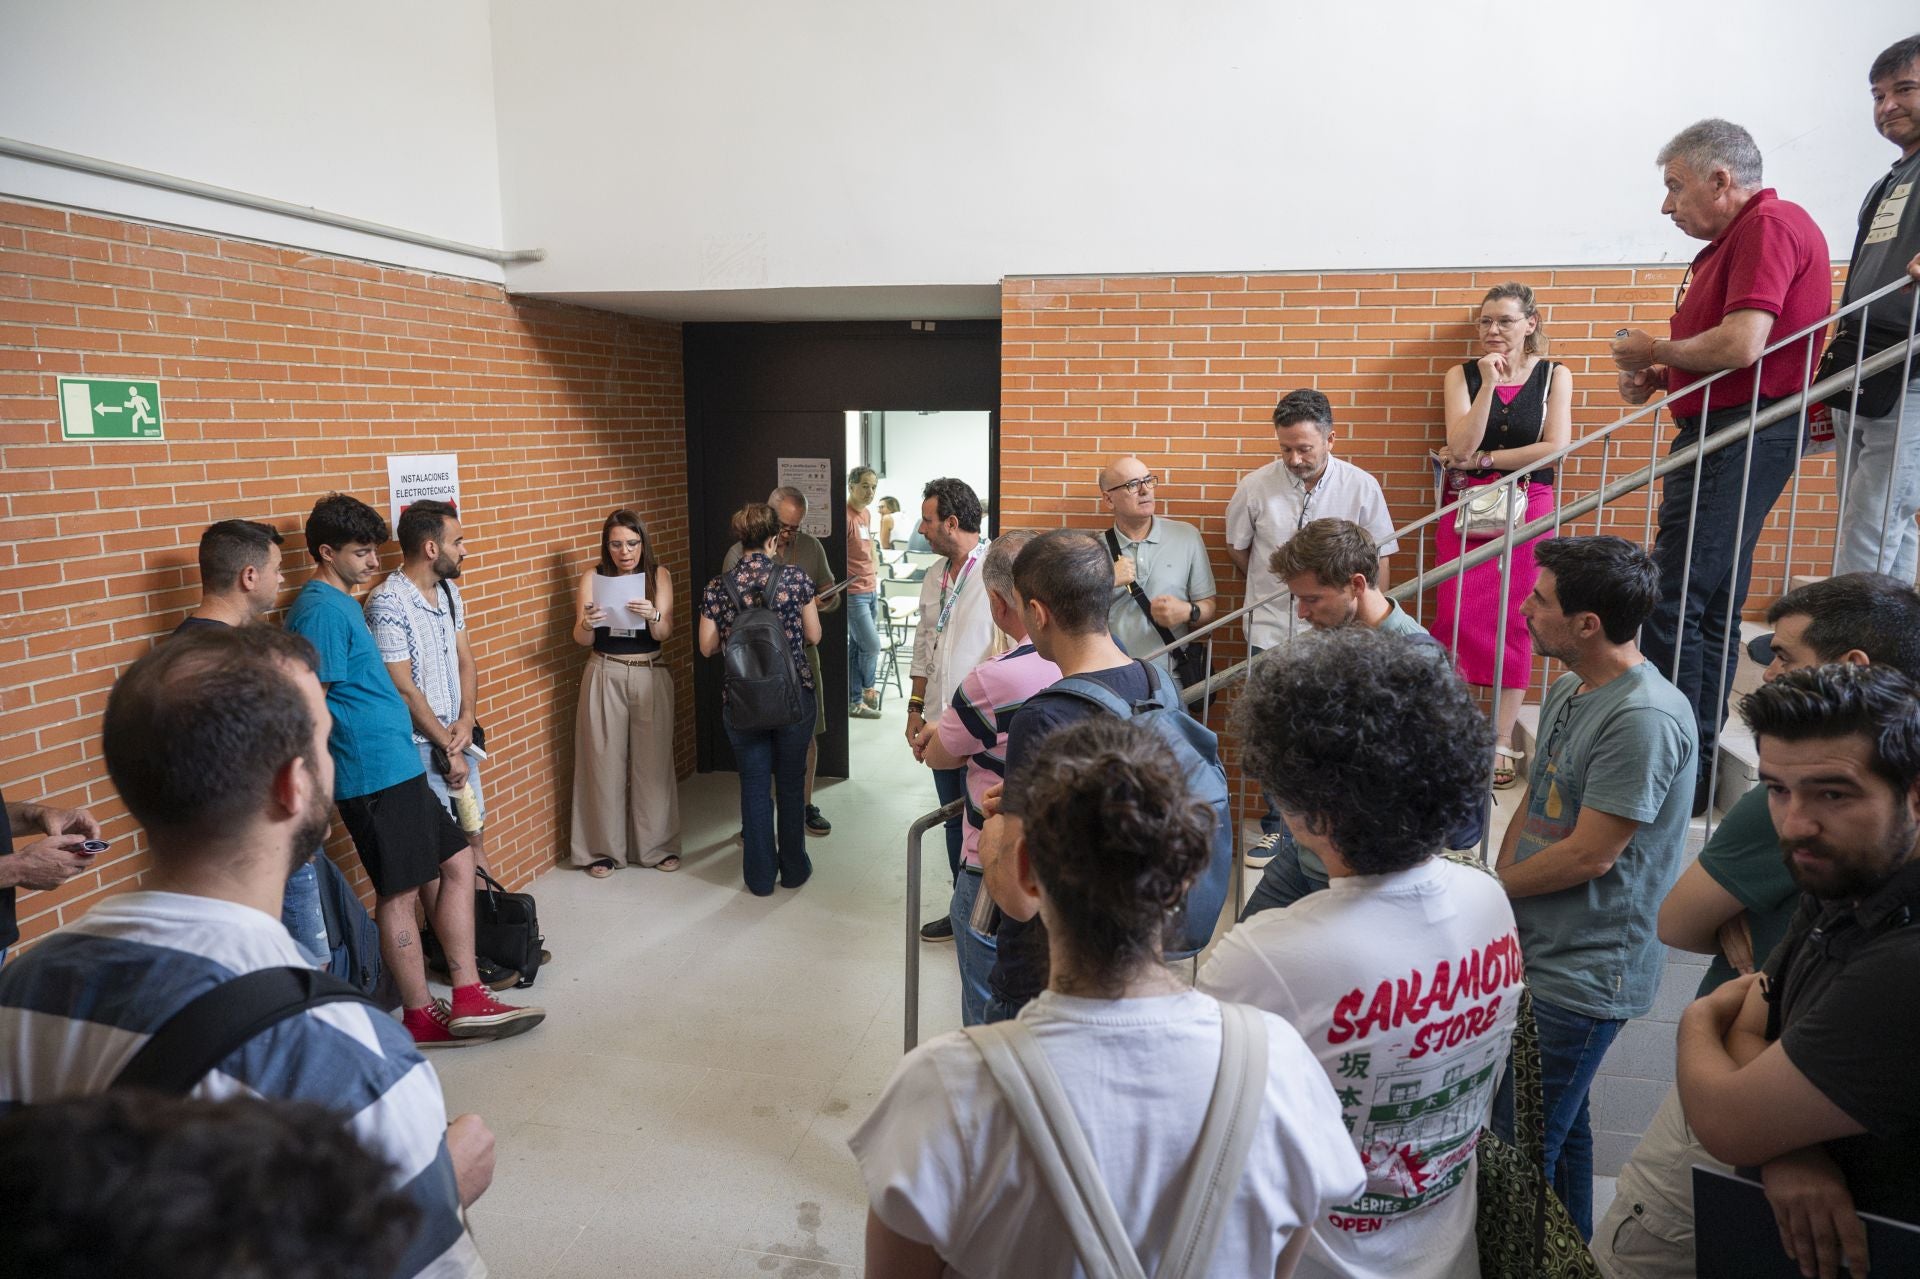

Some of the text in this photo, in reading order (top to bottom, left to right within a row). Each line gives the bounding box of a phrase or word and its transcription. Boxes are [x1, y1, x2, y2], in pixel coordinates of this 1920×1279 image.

[400, 472, 449, 483] INSTALACIONES
[396, 485, 455, 498] ELECTROTÉCNICAS
[1409, 995, 1502, 1060] STORE
[1328, 1212, 1383, 1233] OPEN
